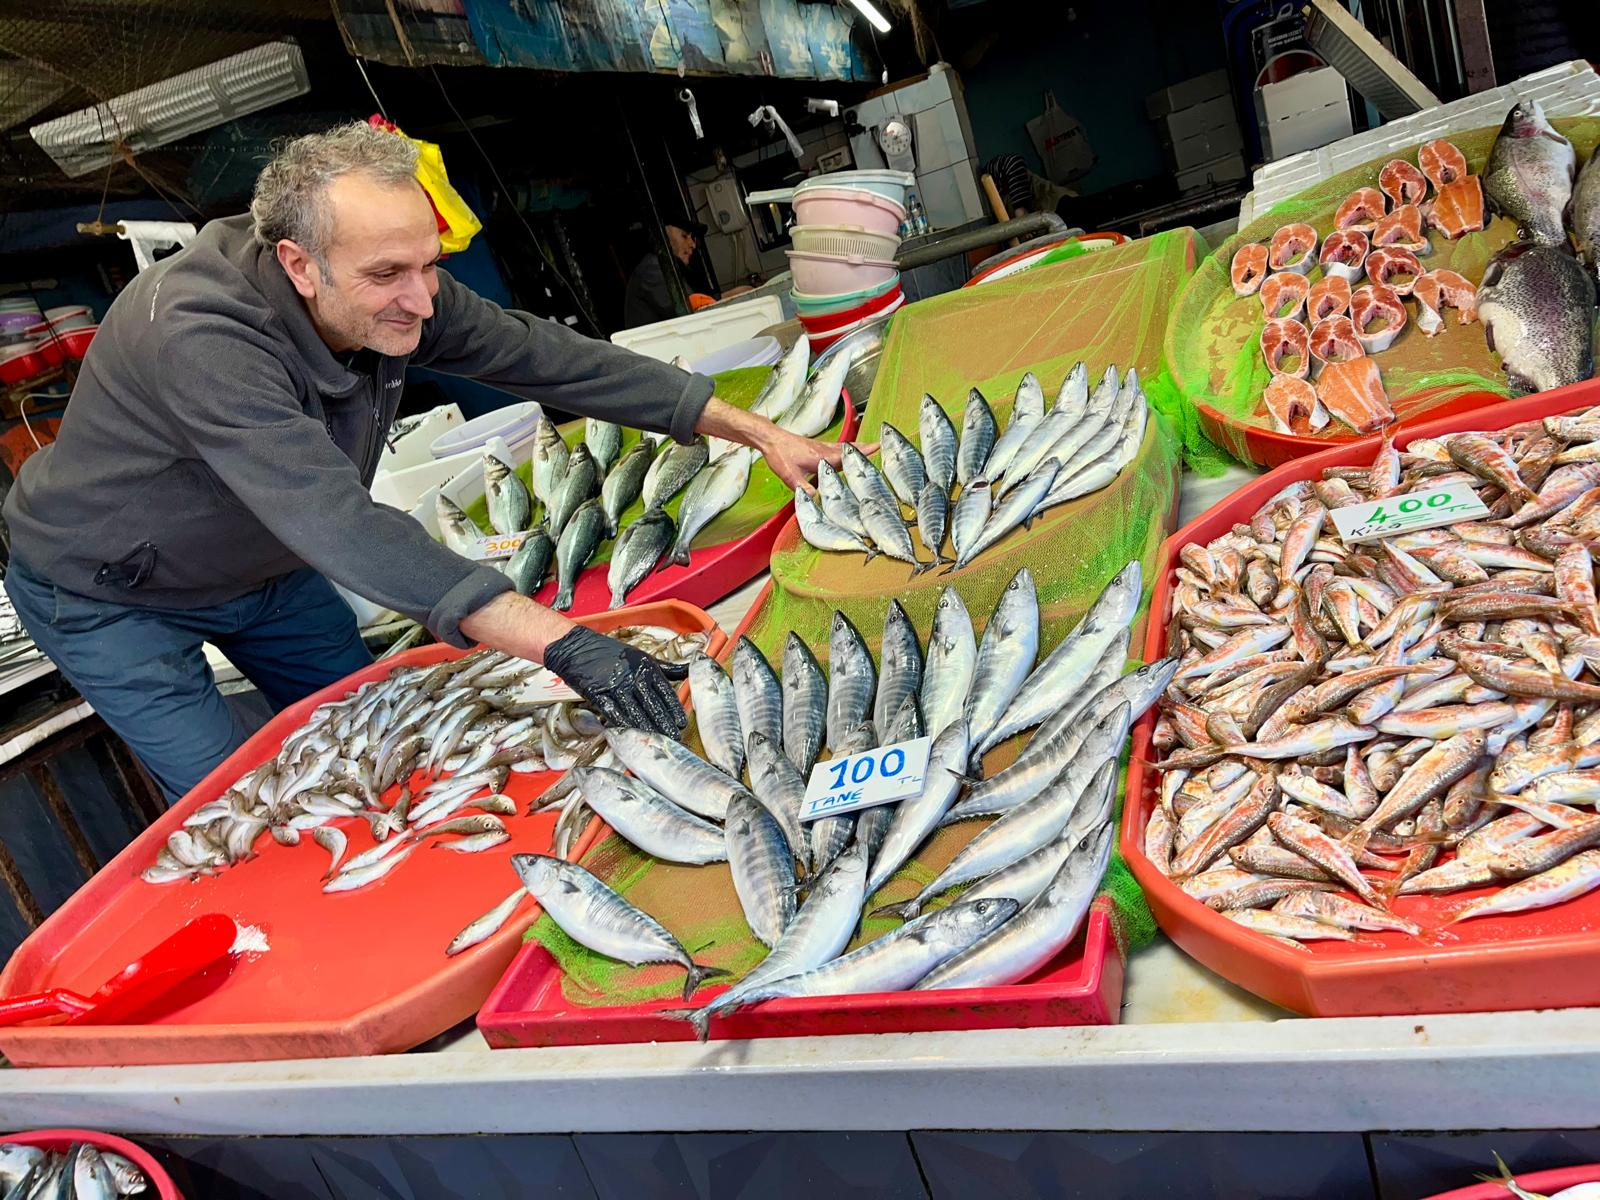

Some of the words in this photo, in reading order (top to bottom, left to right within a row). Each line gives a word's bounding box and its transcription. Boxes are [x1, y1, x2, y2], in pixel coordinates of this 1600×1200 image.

[1366, 493, 1451, 524] 400
[829, 749, 905, 790] 100
[897, 775, 922, 784] TL
[809, 788, 864, 810] TANE
